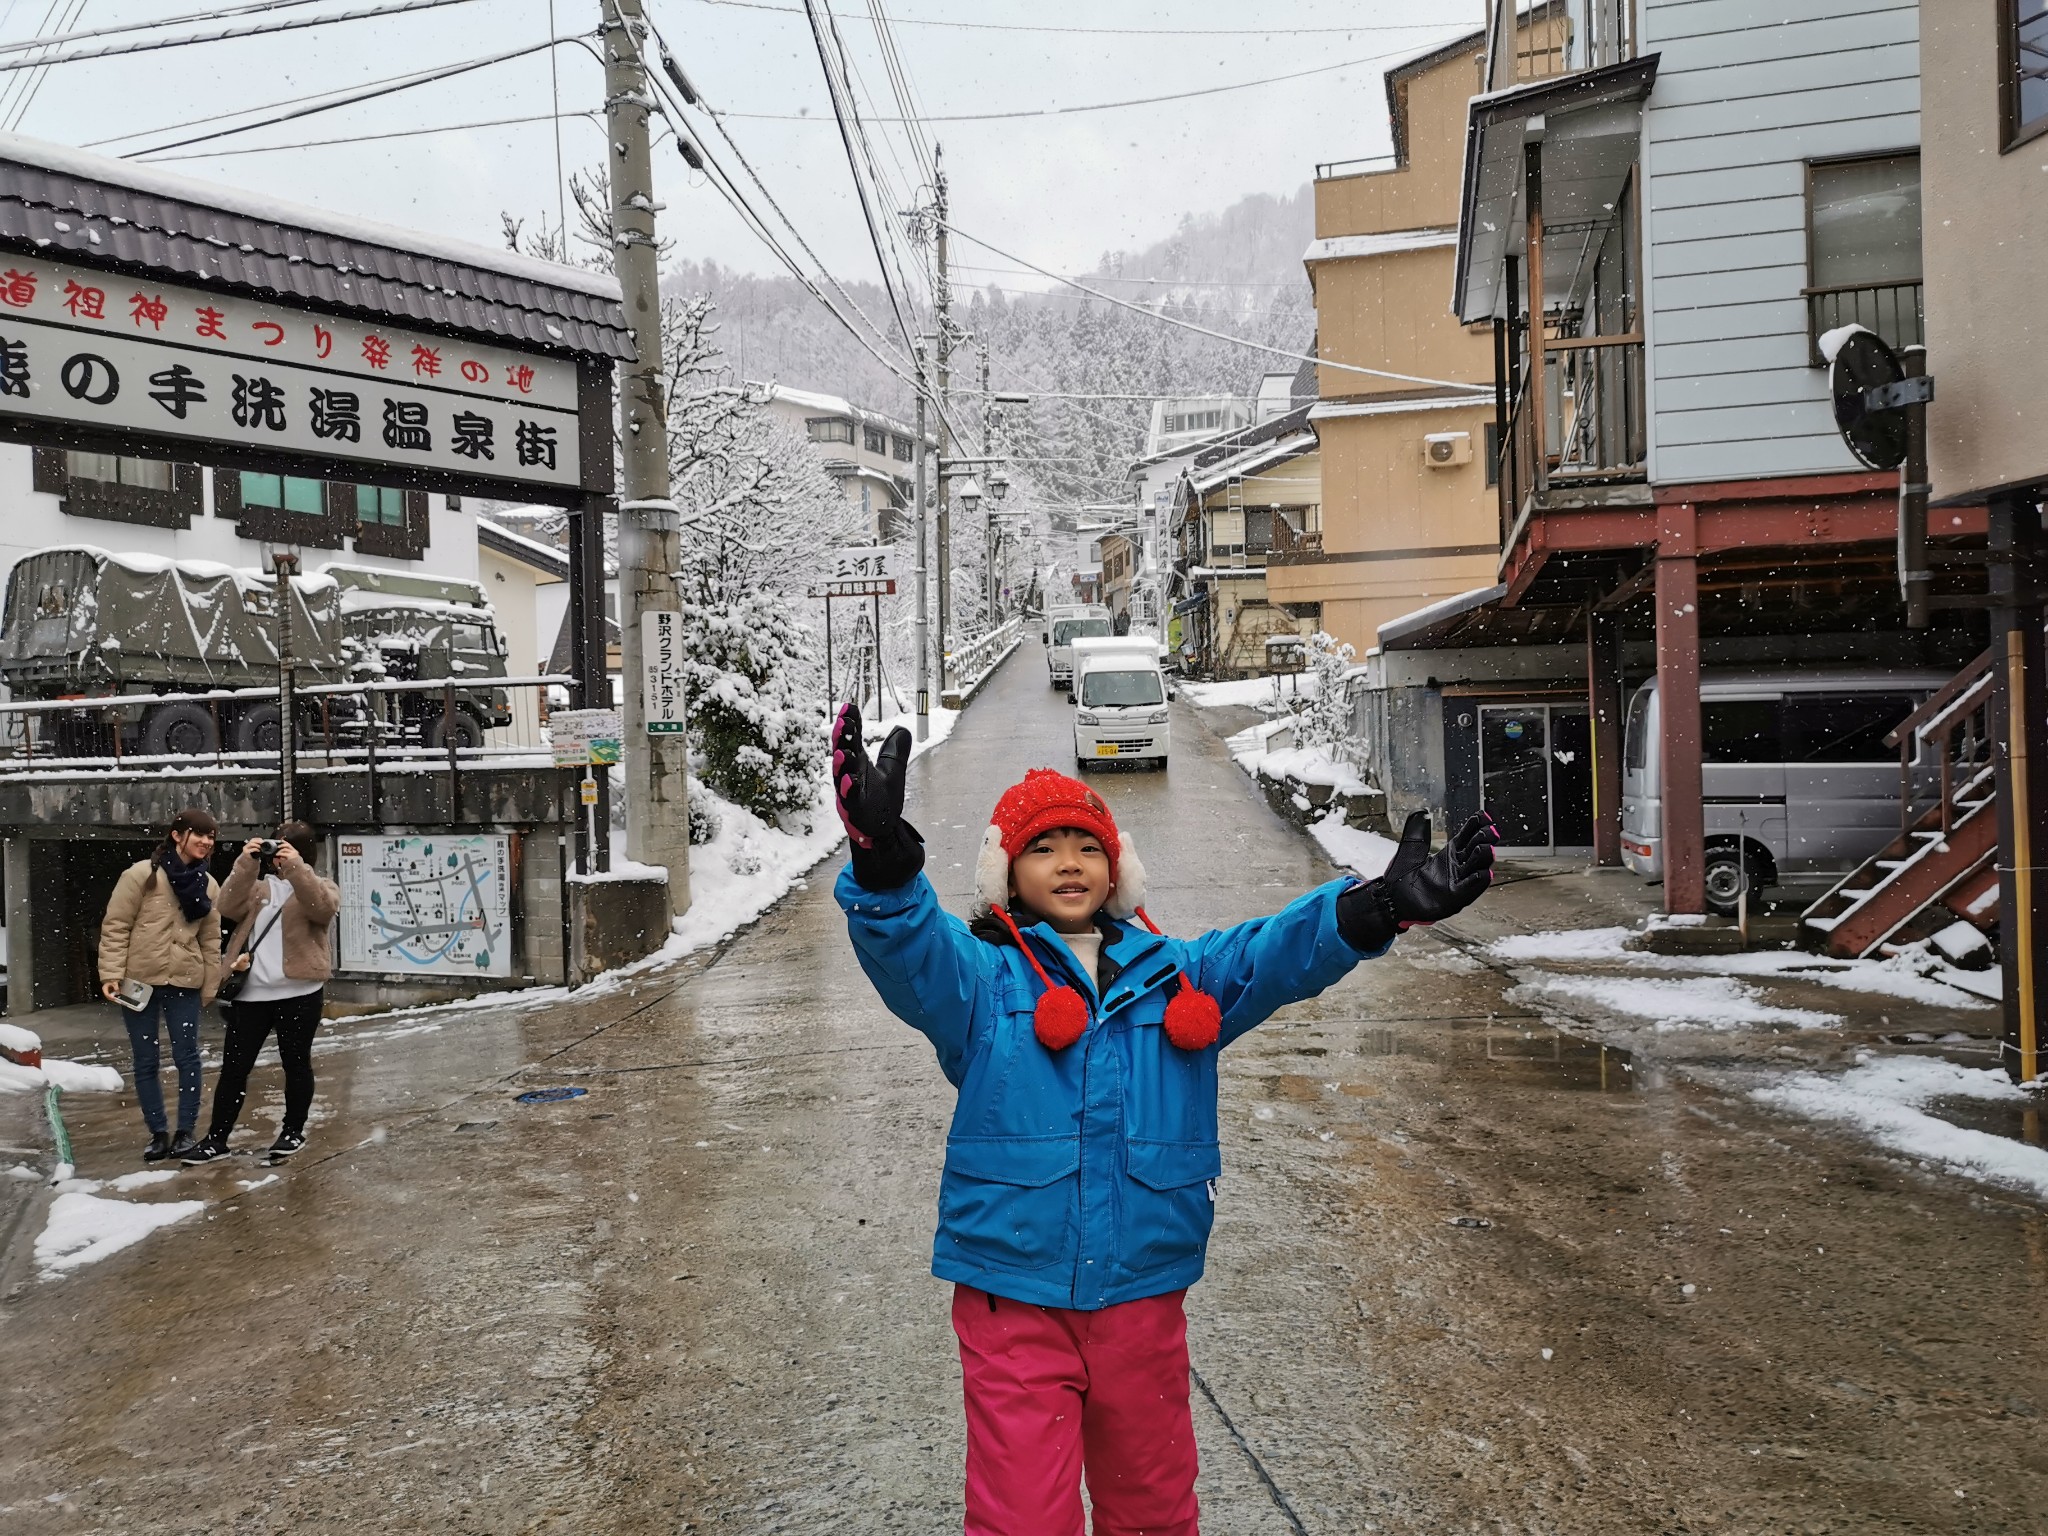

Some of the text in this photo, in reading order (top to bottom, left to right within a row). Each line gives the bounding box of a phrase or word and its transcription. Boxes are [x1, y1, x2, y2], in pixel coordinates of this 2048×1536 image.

[0, 268, 536, 394] 道祖神まつり発祥の地
[836, 555, 889, 578] 三河屋
